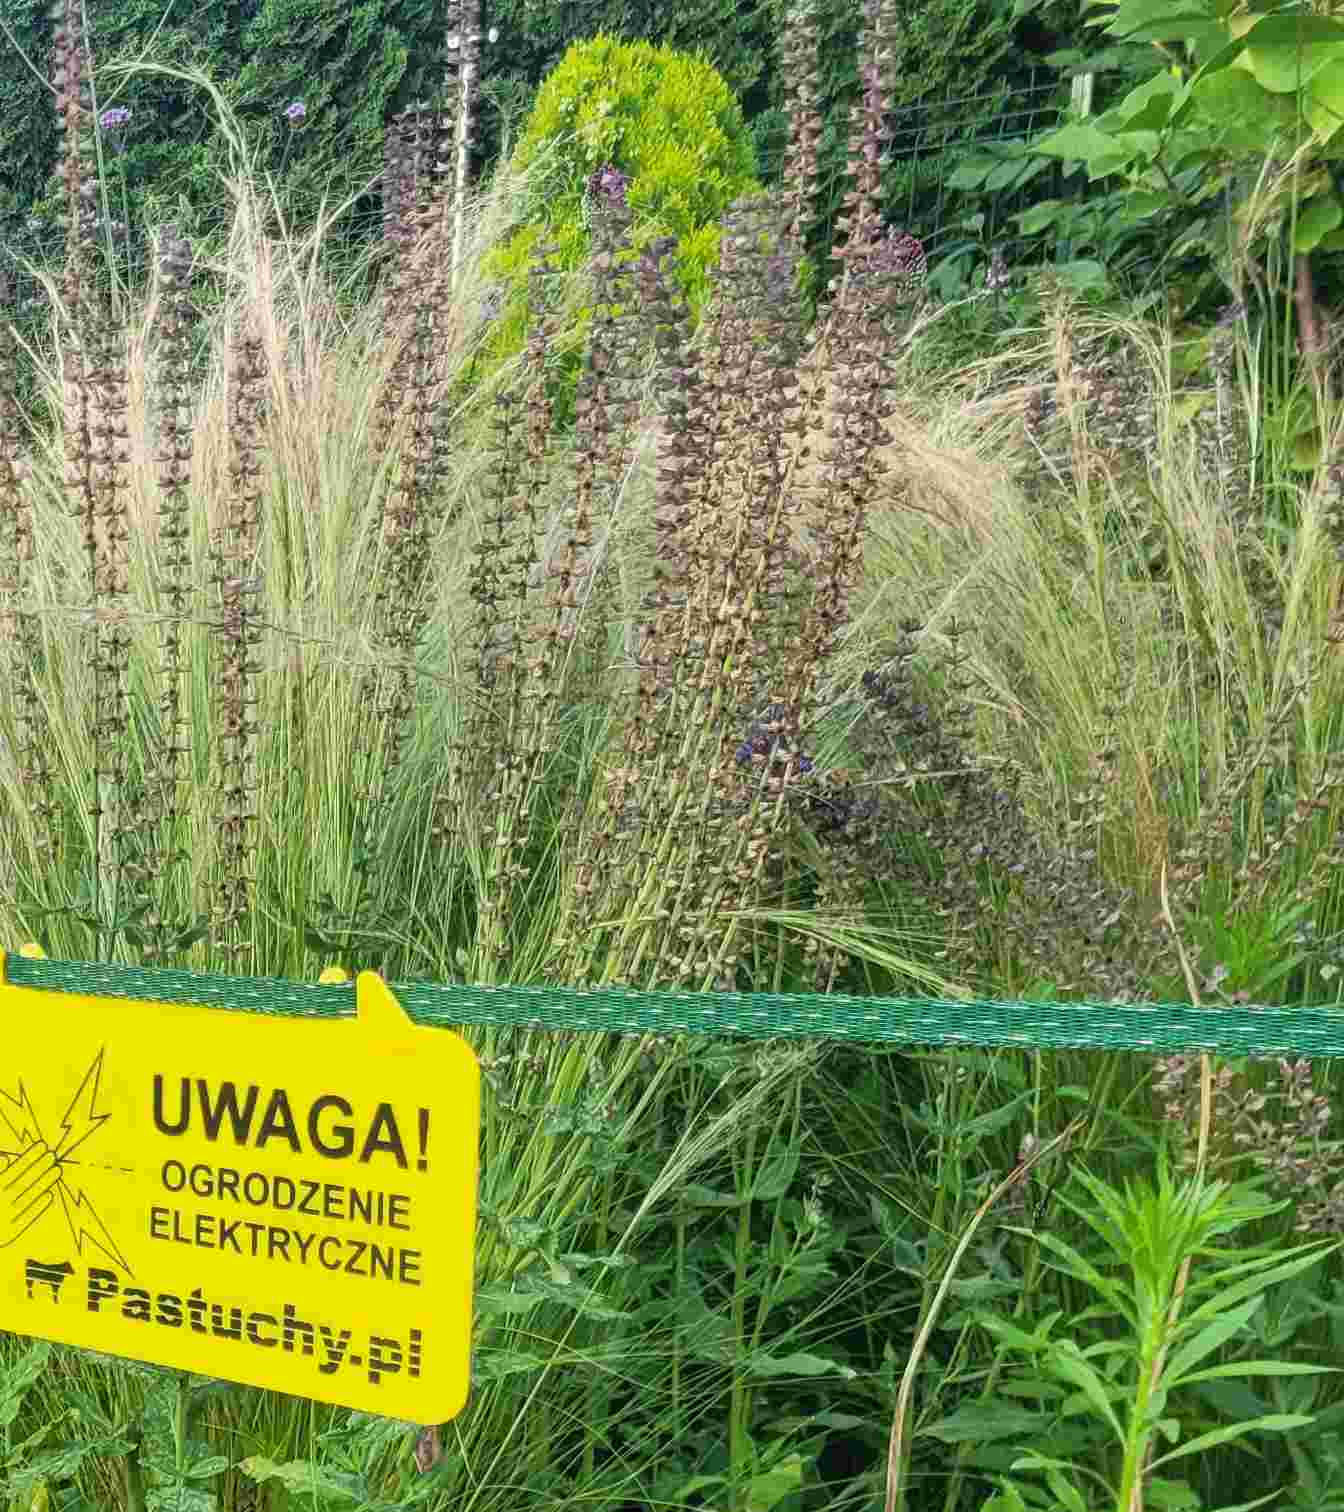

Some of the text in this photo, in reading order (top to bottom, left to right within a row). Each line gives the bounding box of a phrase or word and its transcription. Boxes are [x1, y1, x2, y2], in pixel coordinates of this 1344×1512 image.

[153, 1074, 430, 1171] UWAGA!
[162, 1160, 411, 1230] OGRODZENIE
[150, 1208, 421, 1286] ELEKTRYCZNE
[88, 1268, 421, 1384] Pastuchy.pl
